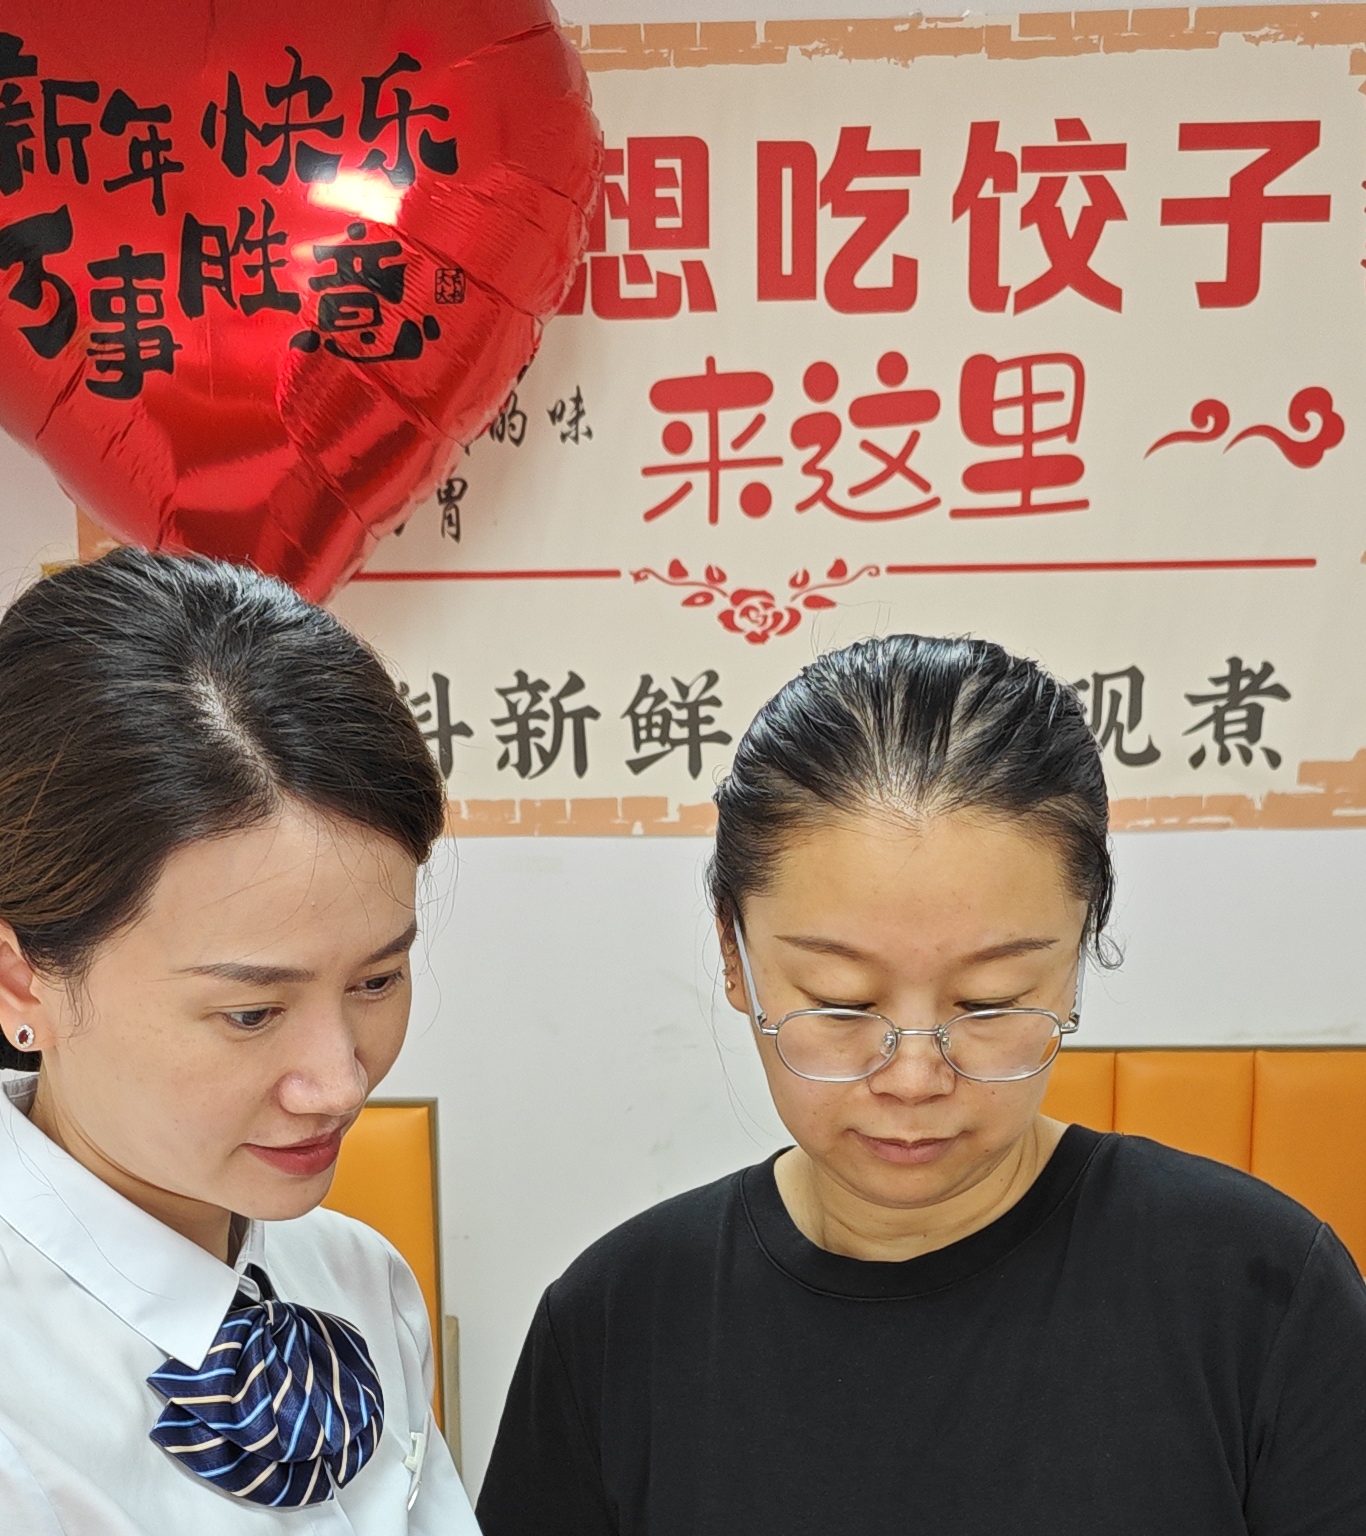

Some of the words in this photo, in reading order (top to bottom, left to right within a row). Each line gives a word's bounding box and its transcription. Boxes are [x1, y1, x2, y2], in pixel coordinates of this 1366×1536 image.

[552, 118, 1331, 321] 想吃饺子
[641, 350, 1090, 527] 来这里
